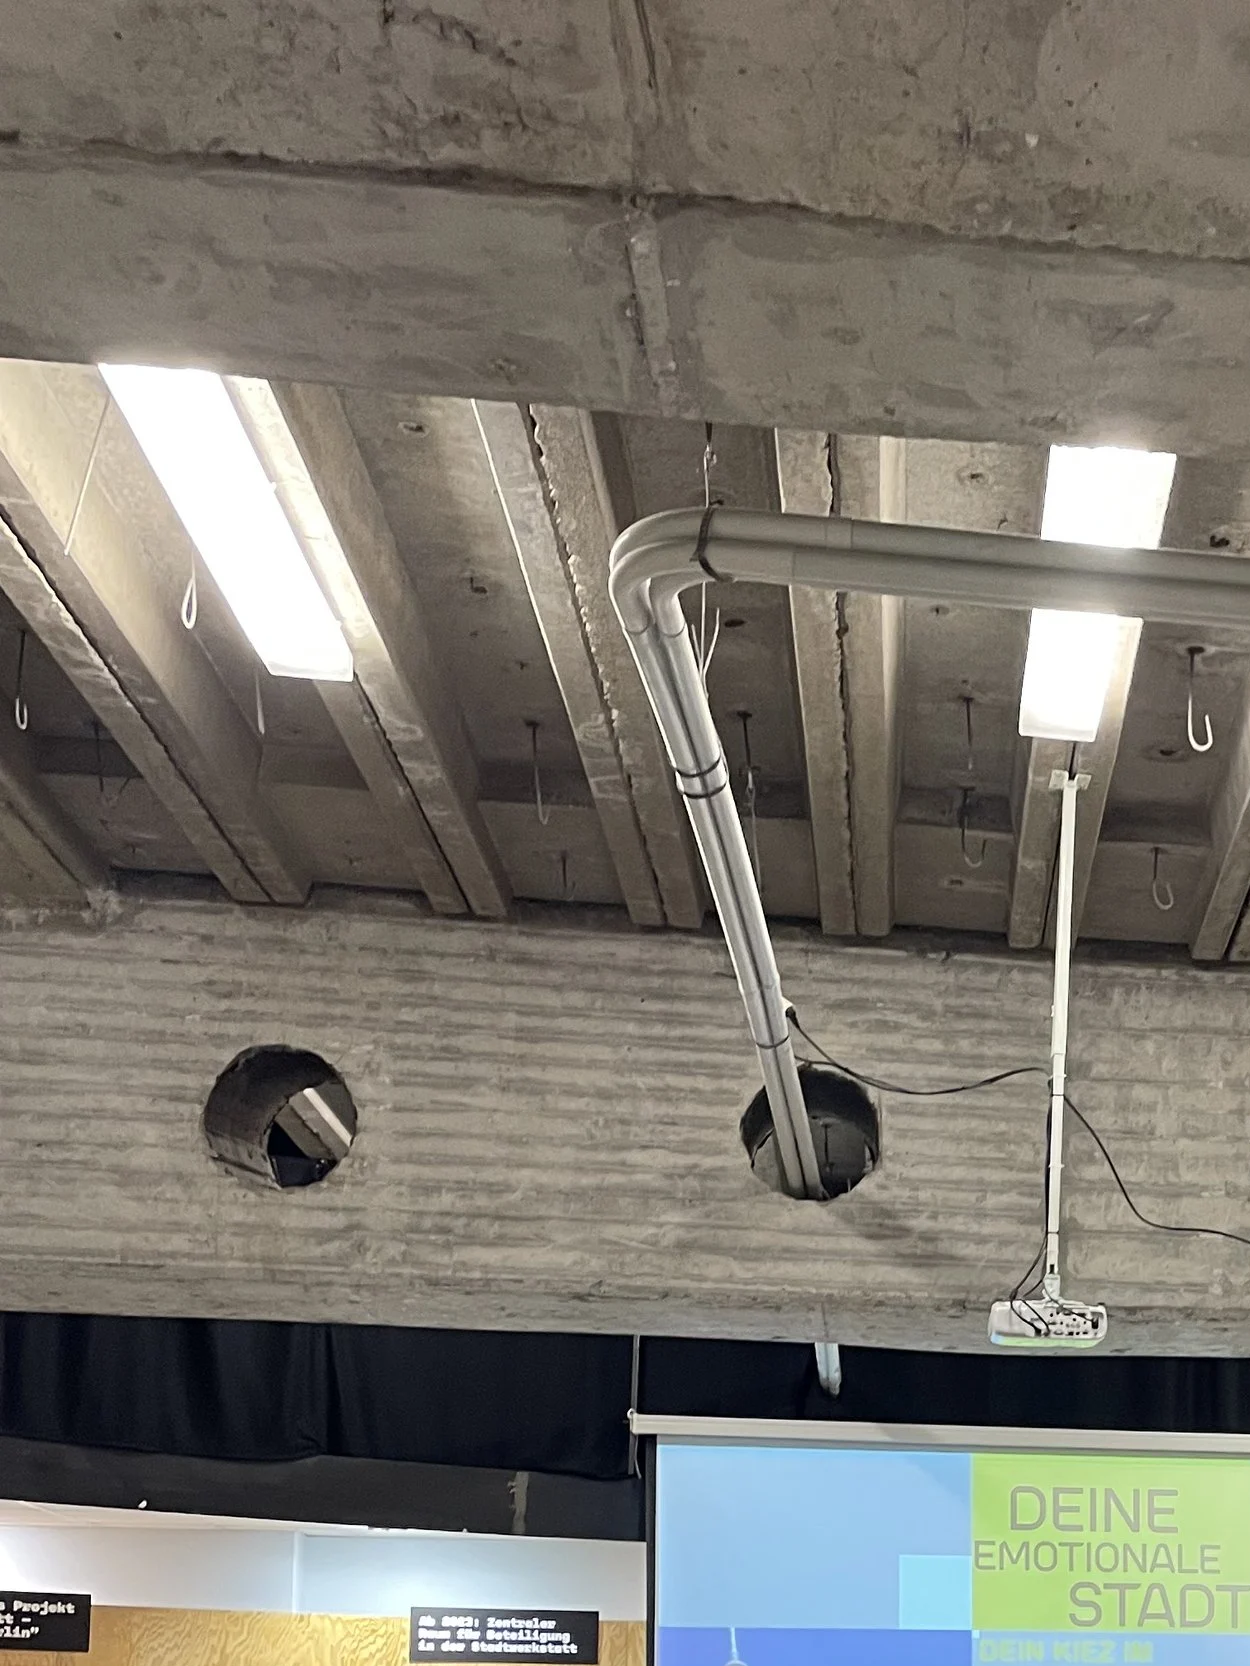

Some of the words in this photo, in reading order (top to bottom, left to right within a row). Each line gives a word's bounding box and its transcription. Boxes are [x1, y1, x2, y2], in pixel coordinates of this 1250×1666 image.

[1010, 1486, 1179, 1534] DEINE
[973, 1540, 1221, 1575] EMOTIONALE
[13, 1600, 75, 1615] Projekt
[487, 1617, 556, 1629] Zentraler
[456, 1628, 480, 1639] für
[486, 1630, 570, 1643] Beteiligung
[471, 1641, 578, 1654] Stadtwerkstatt
[979, 1640, 1044, 1662] DEIN
[1053, 1640, 1117, 1663] KIEZ
[1124, 1641, 1153, 1664] IM
